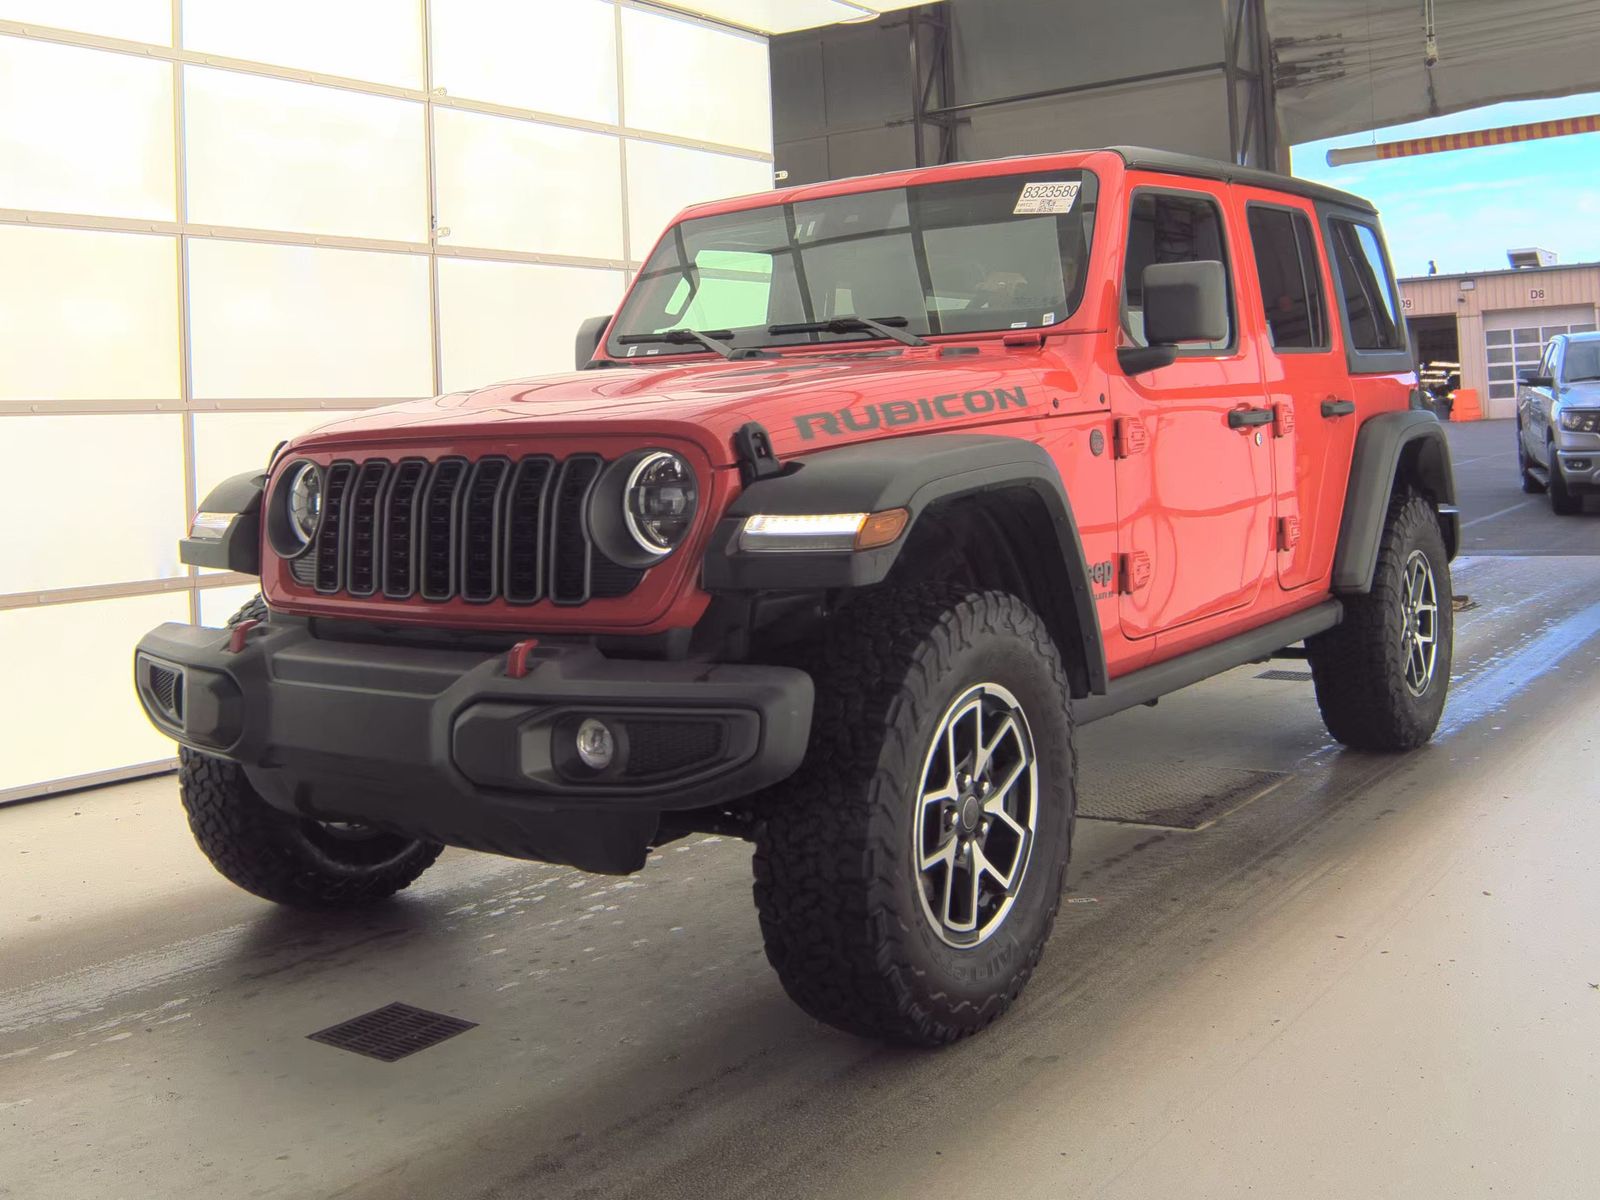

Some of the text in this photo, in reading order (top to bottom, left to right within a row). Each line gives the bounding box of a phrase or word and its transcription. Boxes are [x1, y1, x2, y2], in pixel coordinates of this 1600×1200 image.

[1023, 185, 1079, 199] 8323580
[1530, 289, 1545, 299] D8
[792, 386, 1028, 441] RUBICON
[1086, 560, 1114, 588] eep
